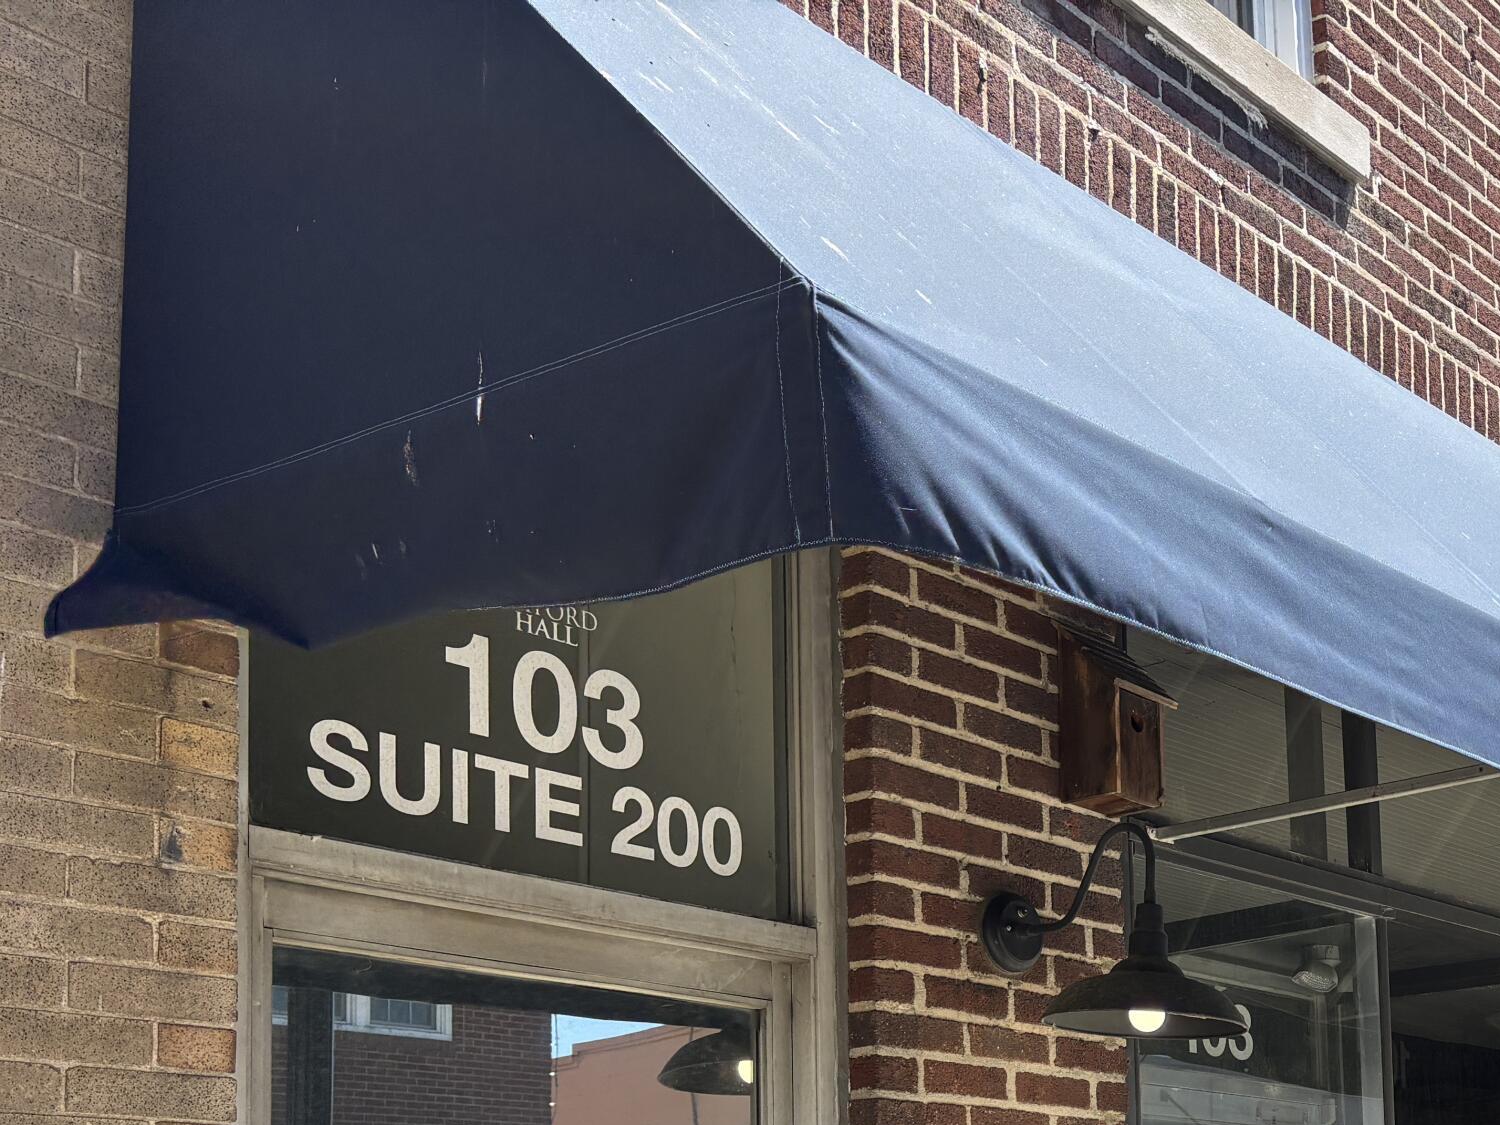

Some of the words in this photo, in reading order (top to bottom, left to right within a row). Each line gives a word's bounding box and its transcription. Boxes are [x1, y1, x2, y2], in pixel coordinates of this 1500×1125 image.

[515, 610, 578, 647] HALL
[445, 633, 644, 770] 103
[306, 719, 584, 847] SUITE
[610, 786, 743, 877] 200
